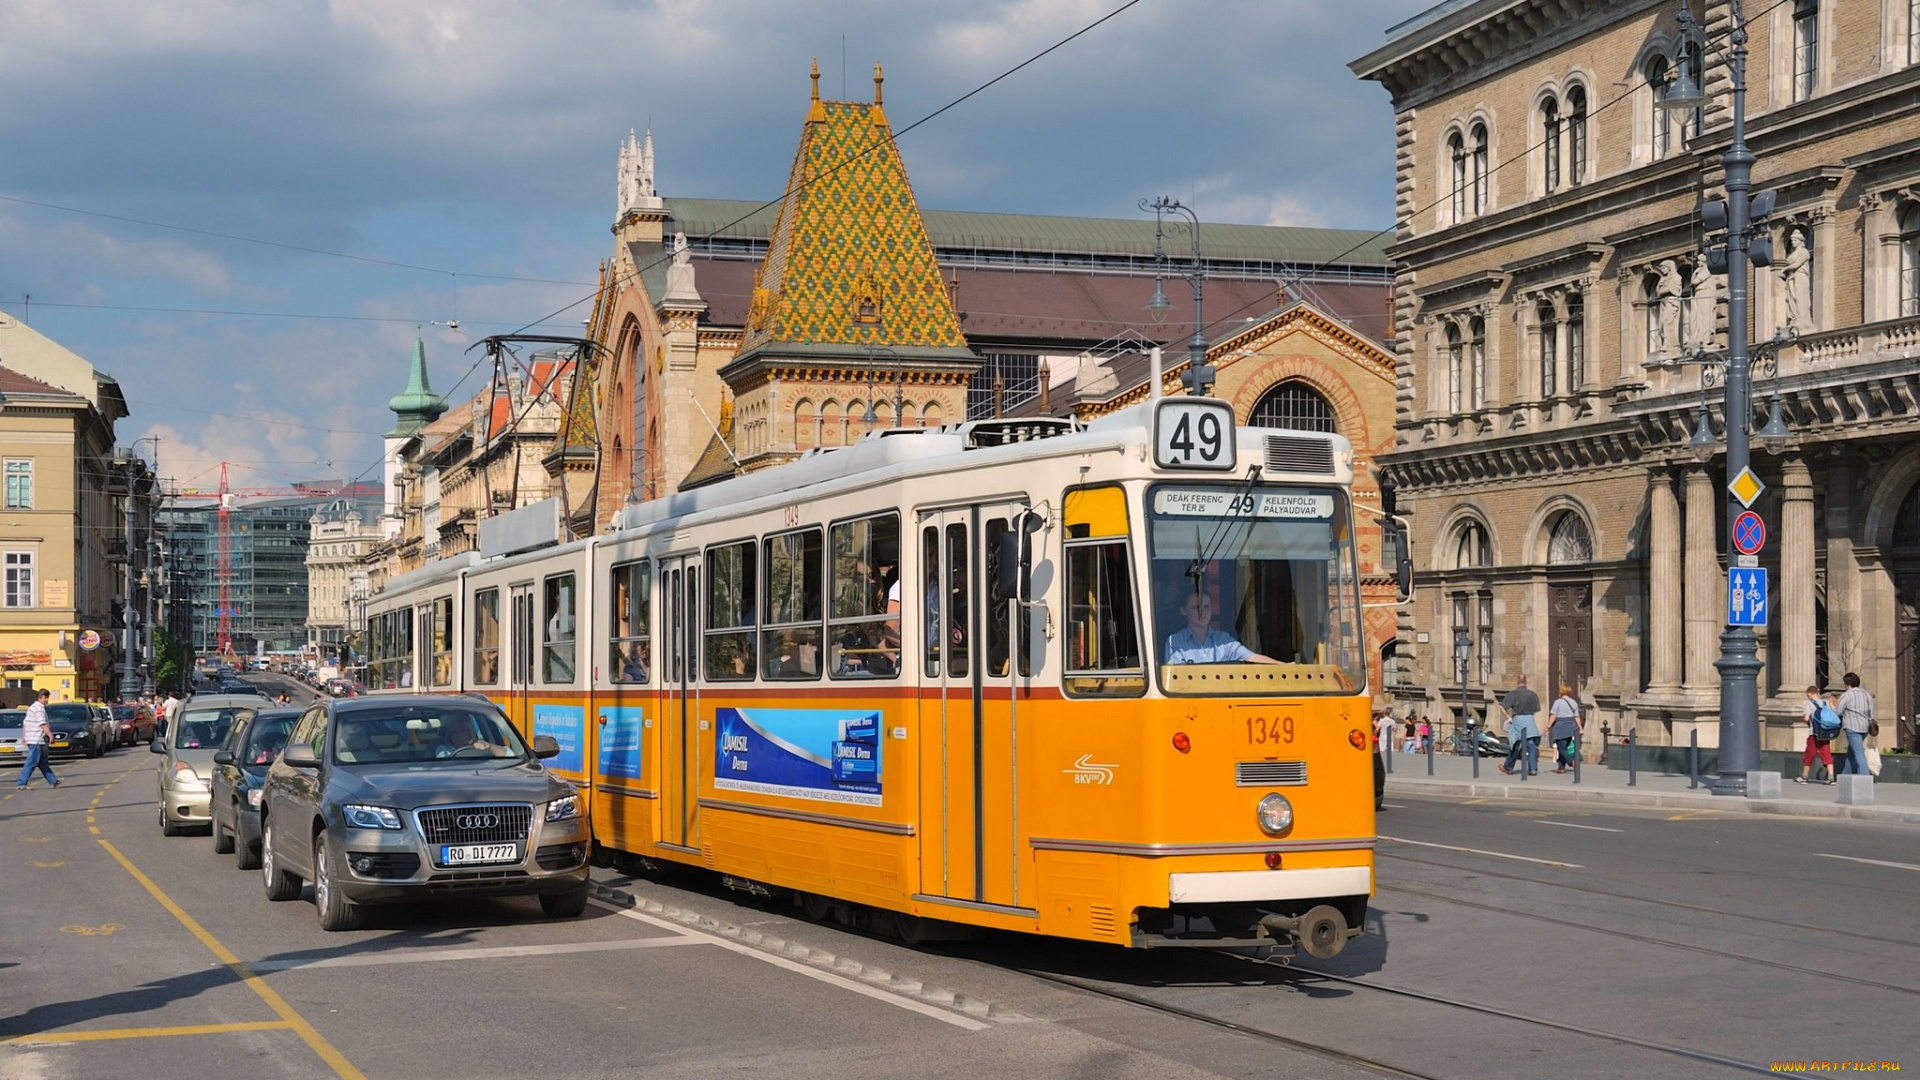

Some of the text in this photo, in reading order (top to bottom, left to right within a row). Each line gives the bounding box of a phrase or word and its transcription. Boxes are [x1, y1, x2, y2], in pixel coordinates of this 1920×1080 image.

[1170, 412, 1221, 461] 49
[1167, 493, 1223, 504] DEÁK FERENC
[1229, 495, 1255, 514] 49
[1265, 496, 1316, 505] KELENFÖLDI
[1182, 502, 1197, 512] TÉR
[1263, 505, 1317, 515] PÁLYAUDVAR
[784, 505, 799, 528] 1349
[1246, 717, 1295, 745] 1349
[724, 734, 748, 752] LAMISIL
[1074, 774, 1091, 784] BKV
[450, 848, 464, 860] RO
